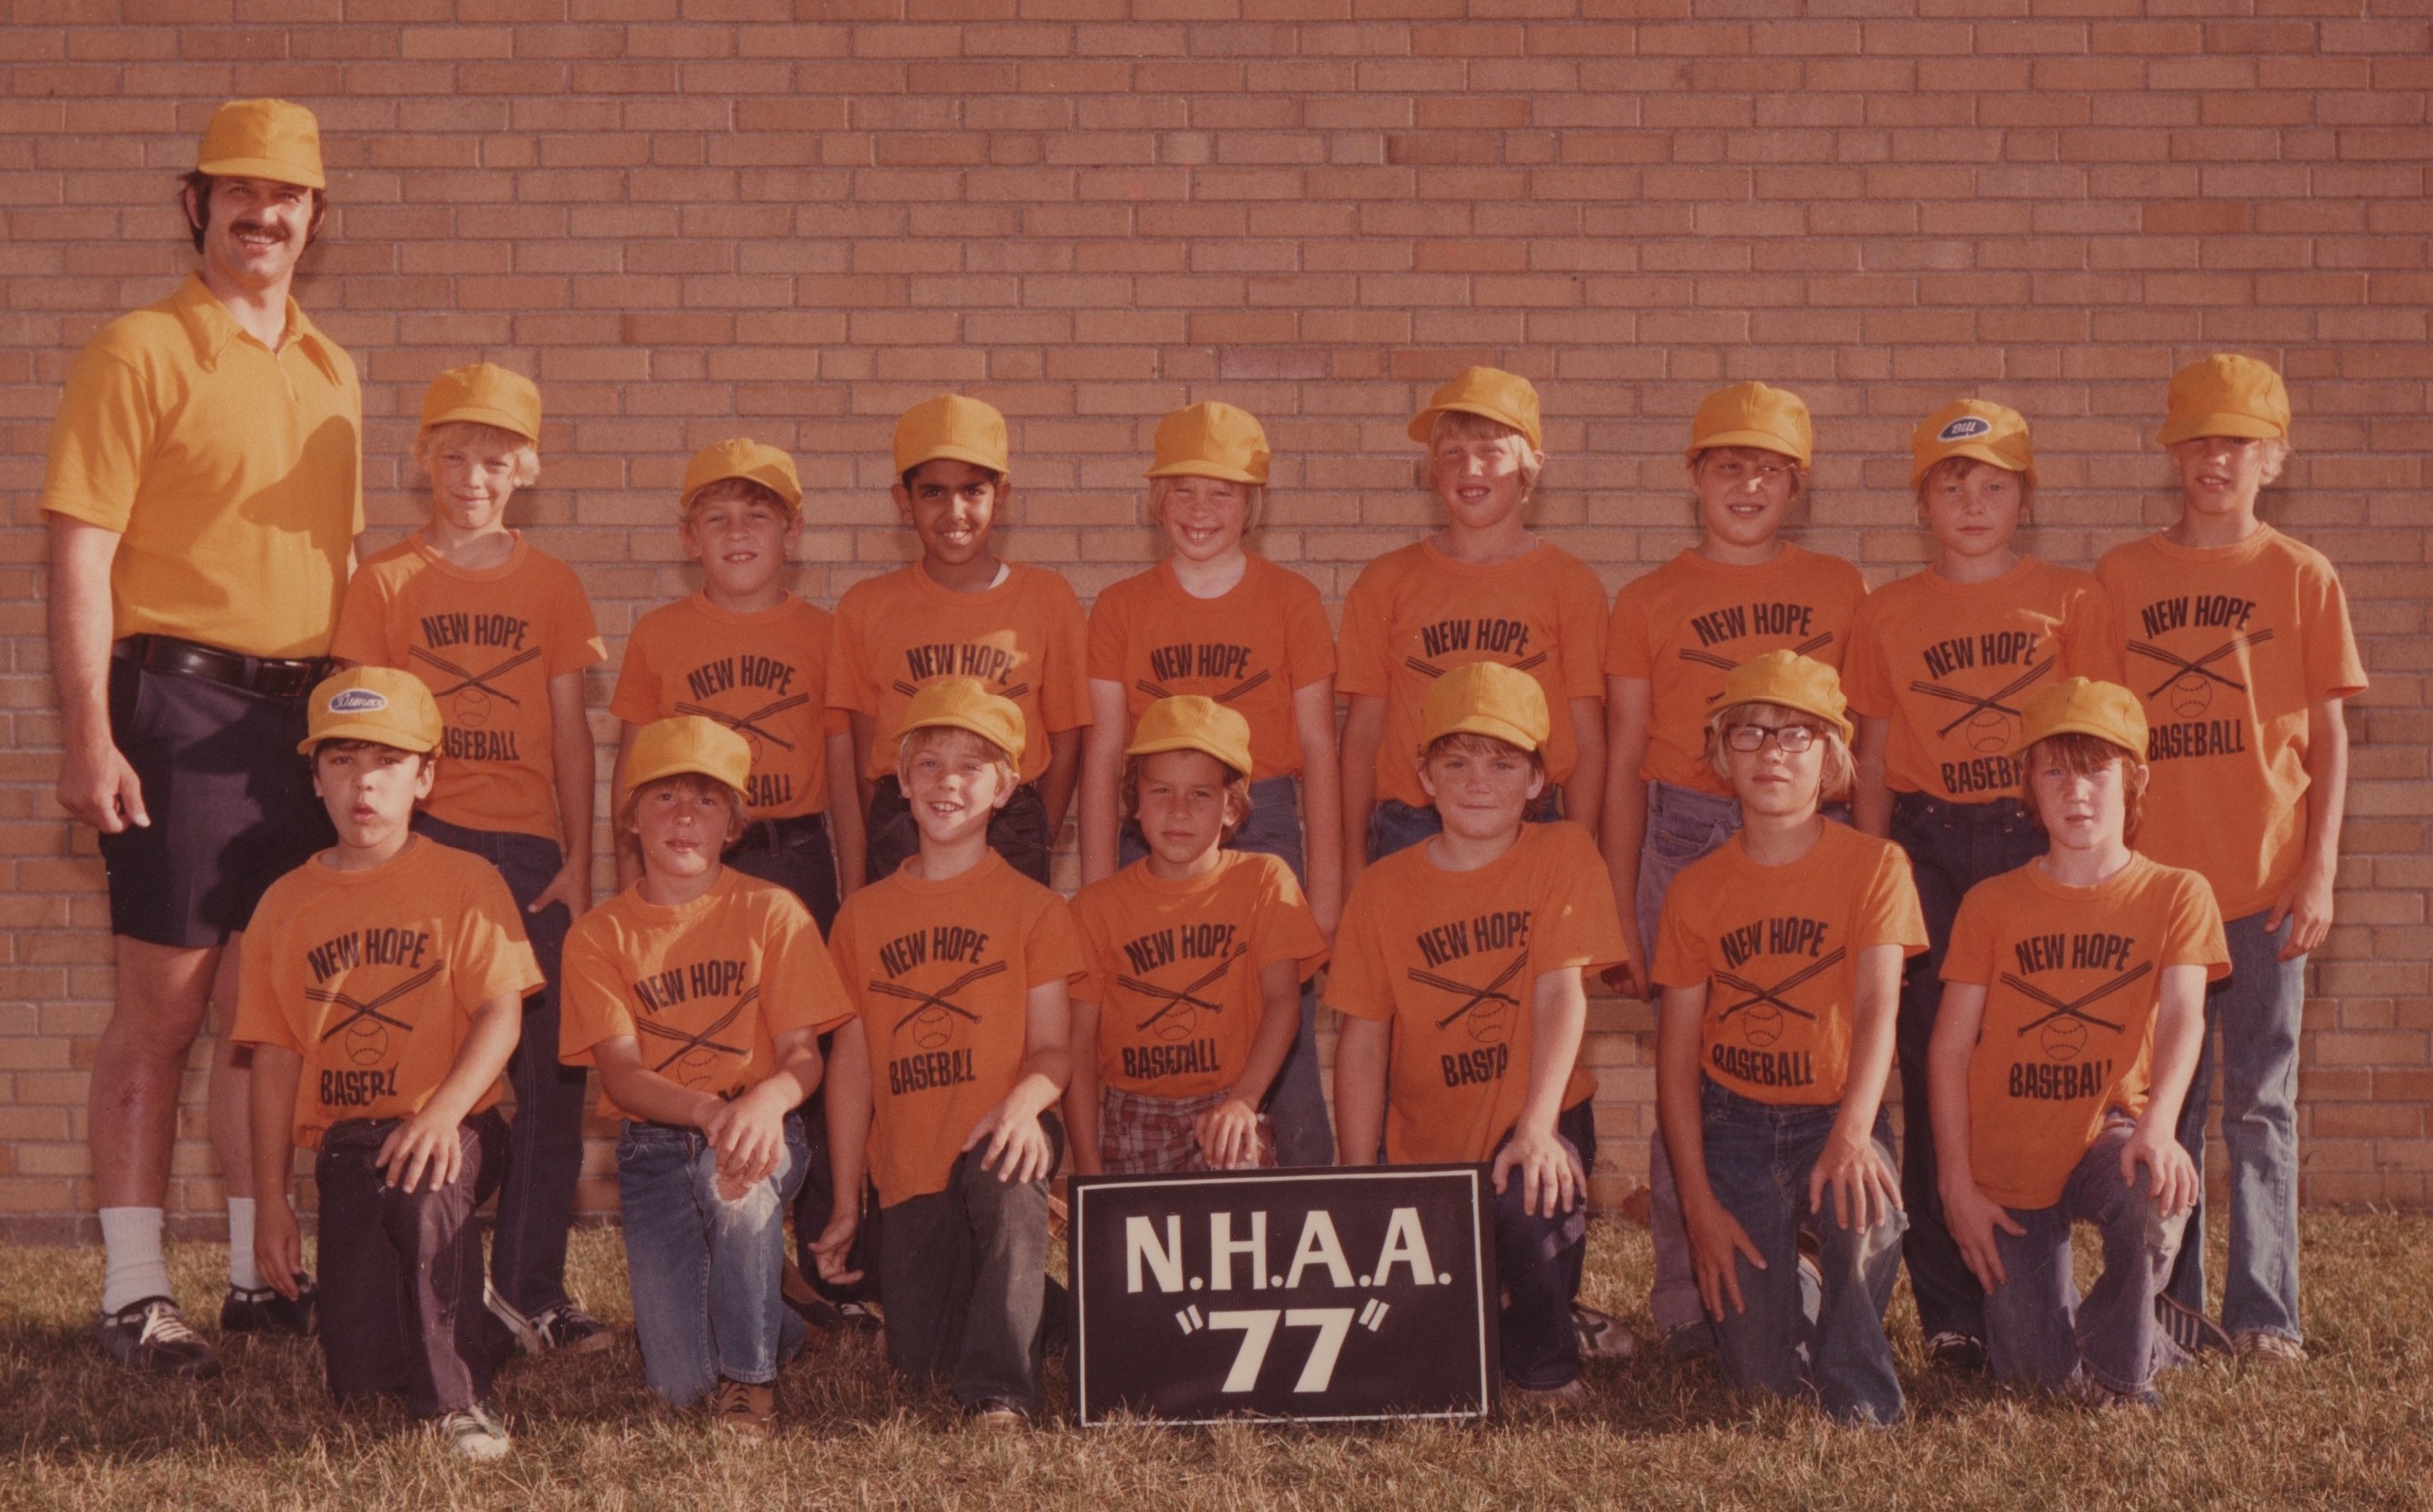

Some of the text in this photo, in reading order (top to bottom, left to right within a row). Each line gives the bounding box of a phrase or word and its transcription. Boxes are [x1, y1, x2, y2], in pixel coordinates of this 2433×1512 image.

[1950, 421, 1976, 435] Bill
[420, 612, 529, 651] NEW HOPE
[1421, 618, 1530, 658] NEW HOPE
[1691, 603, 1813, 646] NEW HOPE
[2139, 595, 2257, 639] NEW HOPE
[686, 654, 796, 700] NEW HOPE
[906, 644, 1016, 685] NEW HOPE
[1151, 643, 1253, 683] NEW HOPE
[1923, 632, 2041, 680] NEW HOPE
[2148, 719, 2246, 762] BASEBALL
[752, 776, 793, 807] BALL
[307, 927, 429, 983] NEW HOPE
[880, 926, 989, 979] NEW HOPE
[1123, 924, 1237, 975] NEW HOPE
[1416, 910, 1531, 968] NEW HOPE
[1769, 917, 1829, 958] HOPE
[2014, 933, 2135, 975] NEW HOPE
[633, 959, 747, 1015] NEW HOPE
[1712, 1042, 1814, 1088] BASEBALL
[1126, 1207, 1452, 1293] N.H.A.A.
[1175, 1297, 1391, 1393] "77"
